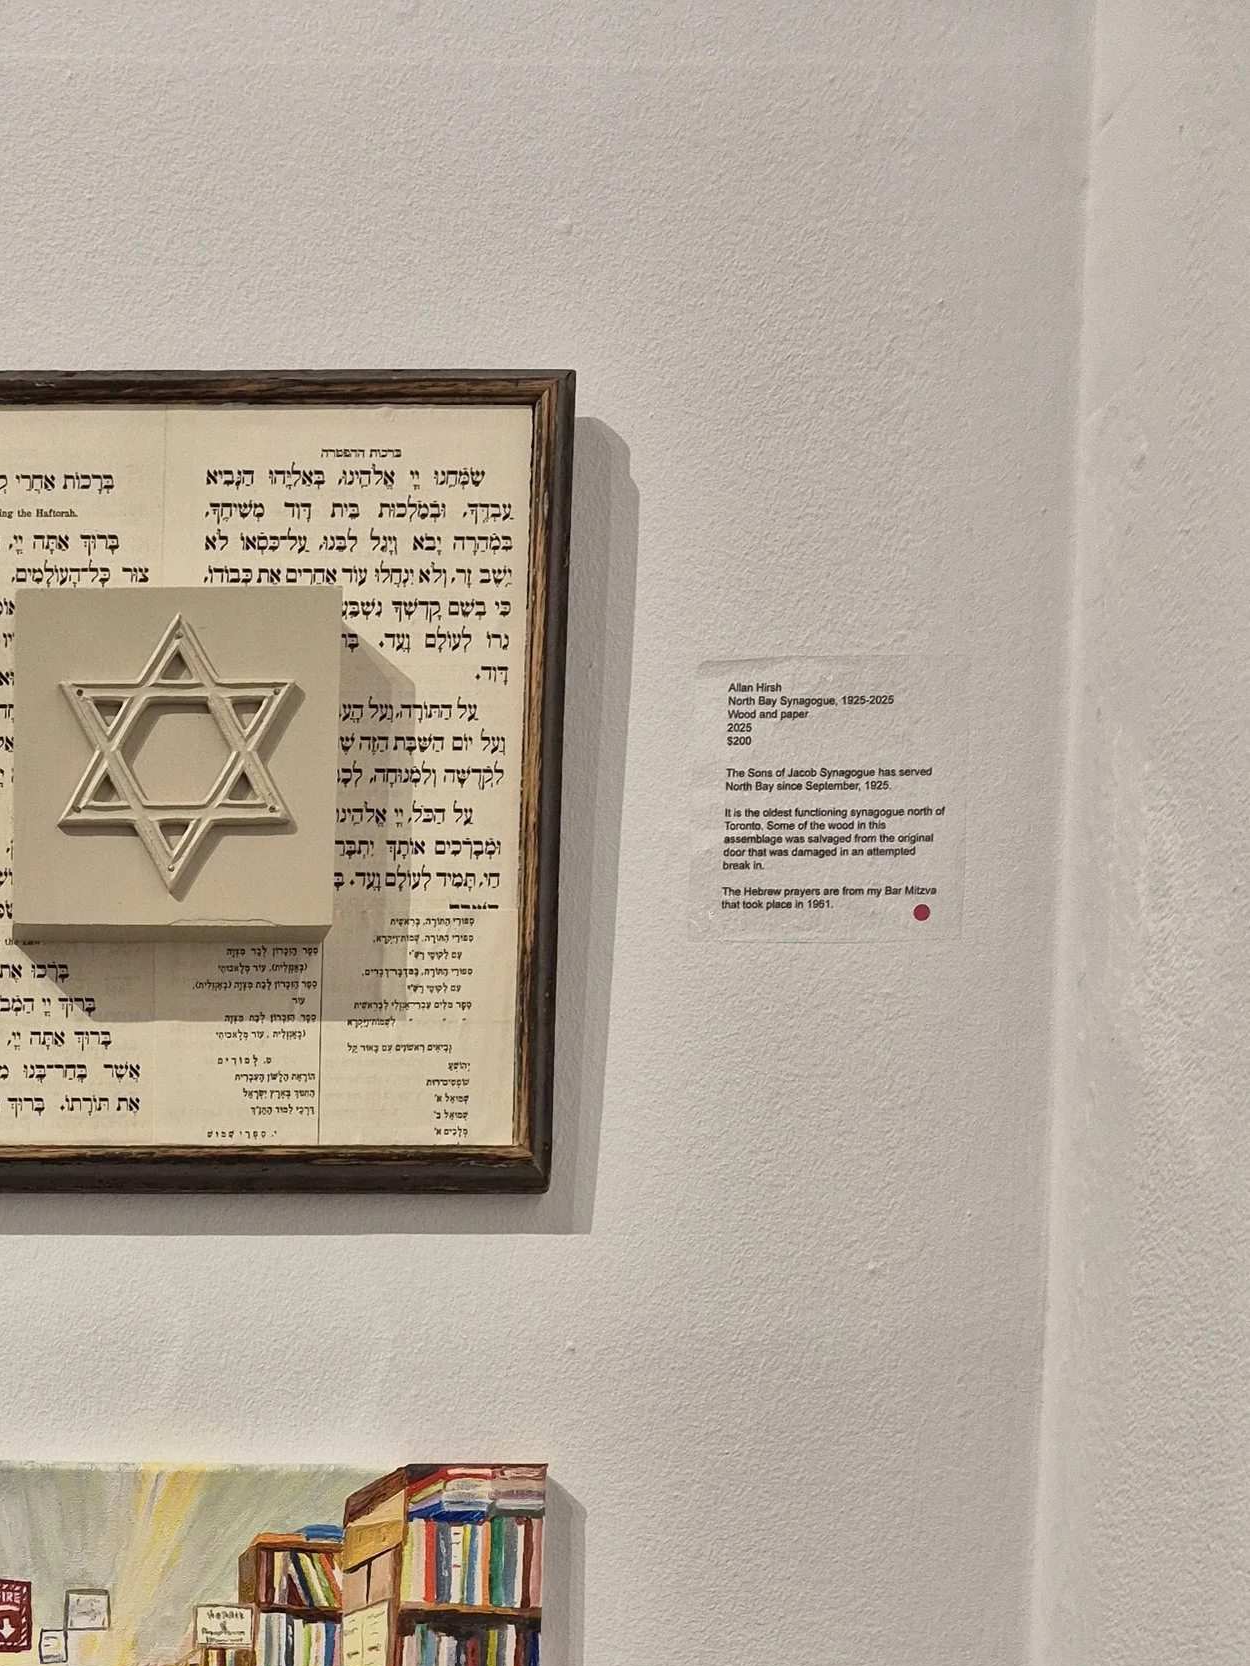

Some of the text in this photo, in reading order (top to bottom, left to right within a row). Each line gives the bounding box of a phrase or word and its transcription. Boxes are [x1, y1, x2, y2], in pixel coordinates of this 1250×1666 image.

[17, 508, 32, 517] the
[35, 508, 78, 517] Haftorah.
[727, 682, 782, 692] Allan Hirsh
[728, 694, 894, 707] North Bay Synagogue, 1925-2025
[727, 709, 809, 721] Wood and paper
[726, 722, 752, 732] 2025
[726, 735, 752, 746] $200
[725, 766, 932, 779] The Sons of Jacob Synagogue has served
[725, 781, 752, 791] North
[755, 781, 774, 793] Bay
[776, 780, 802, 790] since
[804, 780, 861, 792] September,
[724, 805, 945, 818] It is the oldest functioning synagogue north of
[724, 820, 886, 830] Toronto. Some of the wood in this
[723, 833, 783, 845] assemblage
[807, 833, 851, 845] salvaged
[854, 833, 876, 843] from
[879, 833, 895, 842] the
[897, 832, 933, 844] original
[722, 846, 916, 859] door that was damaged in an attempted
[722, 859, 764, 870] break in.
[721, 886, 741, 896] The
[743, 886, 782, 896] Hebrew
[783, 888, 820, 898] prayers
[842, 885, 864, 895] from
[866, 888, 882, 897] my
[884, 885, 902, 895] Bar
[904, 885, 937, 895] Mitzva
[721, 899, 833, 911] that took place in 1961.
[4, 938, 19, 946] the
